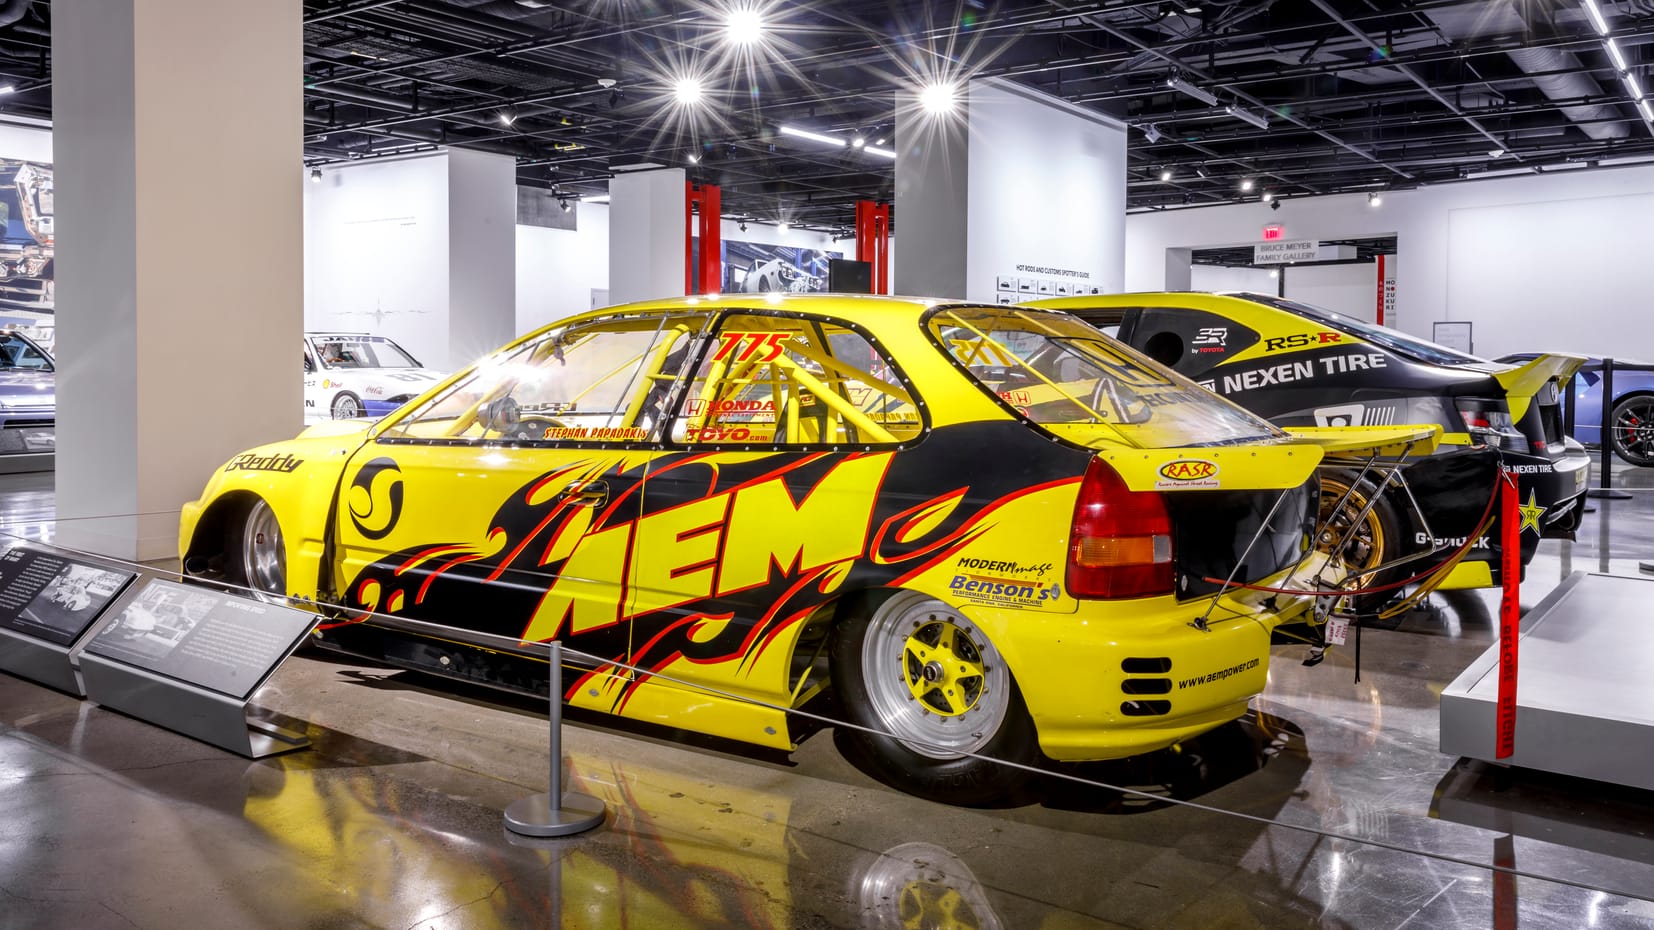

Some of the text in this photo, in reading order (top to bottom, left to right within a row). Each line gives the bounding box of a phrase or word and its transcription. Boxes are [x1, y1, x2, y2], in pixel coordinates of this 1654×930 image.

[1260, 242, 1312, 252] BRUCE MEYER
[1256, 252, 1316, 262] FAMILY GALLERY
[712, 332, 792, 362] 775
[1223, 353, 1387, 394] NEXEN TIRE
[707, 400, 777, 411] HONDA
[544, 427, 648, 440] STEPHAN PAPADAKIS
[224, 453, 304, 473] GReddy
[1167, 462, 1213, 478] RASR
[1513, 464, 1553, 474] NEXEN TIRE
[519, 452, 895, 645] AEM
[949, 575, 1051, 600] Benson's
[952, 589, 991, 600] PERFORMANCE
[1018, 597, 1043, 606] MACHINE
[1178, 657, 1260, 690] www.aempower.com
